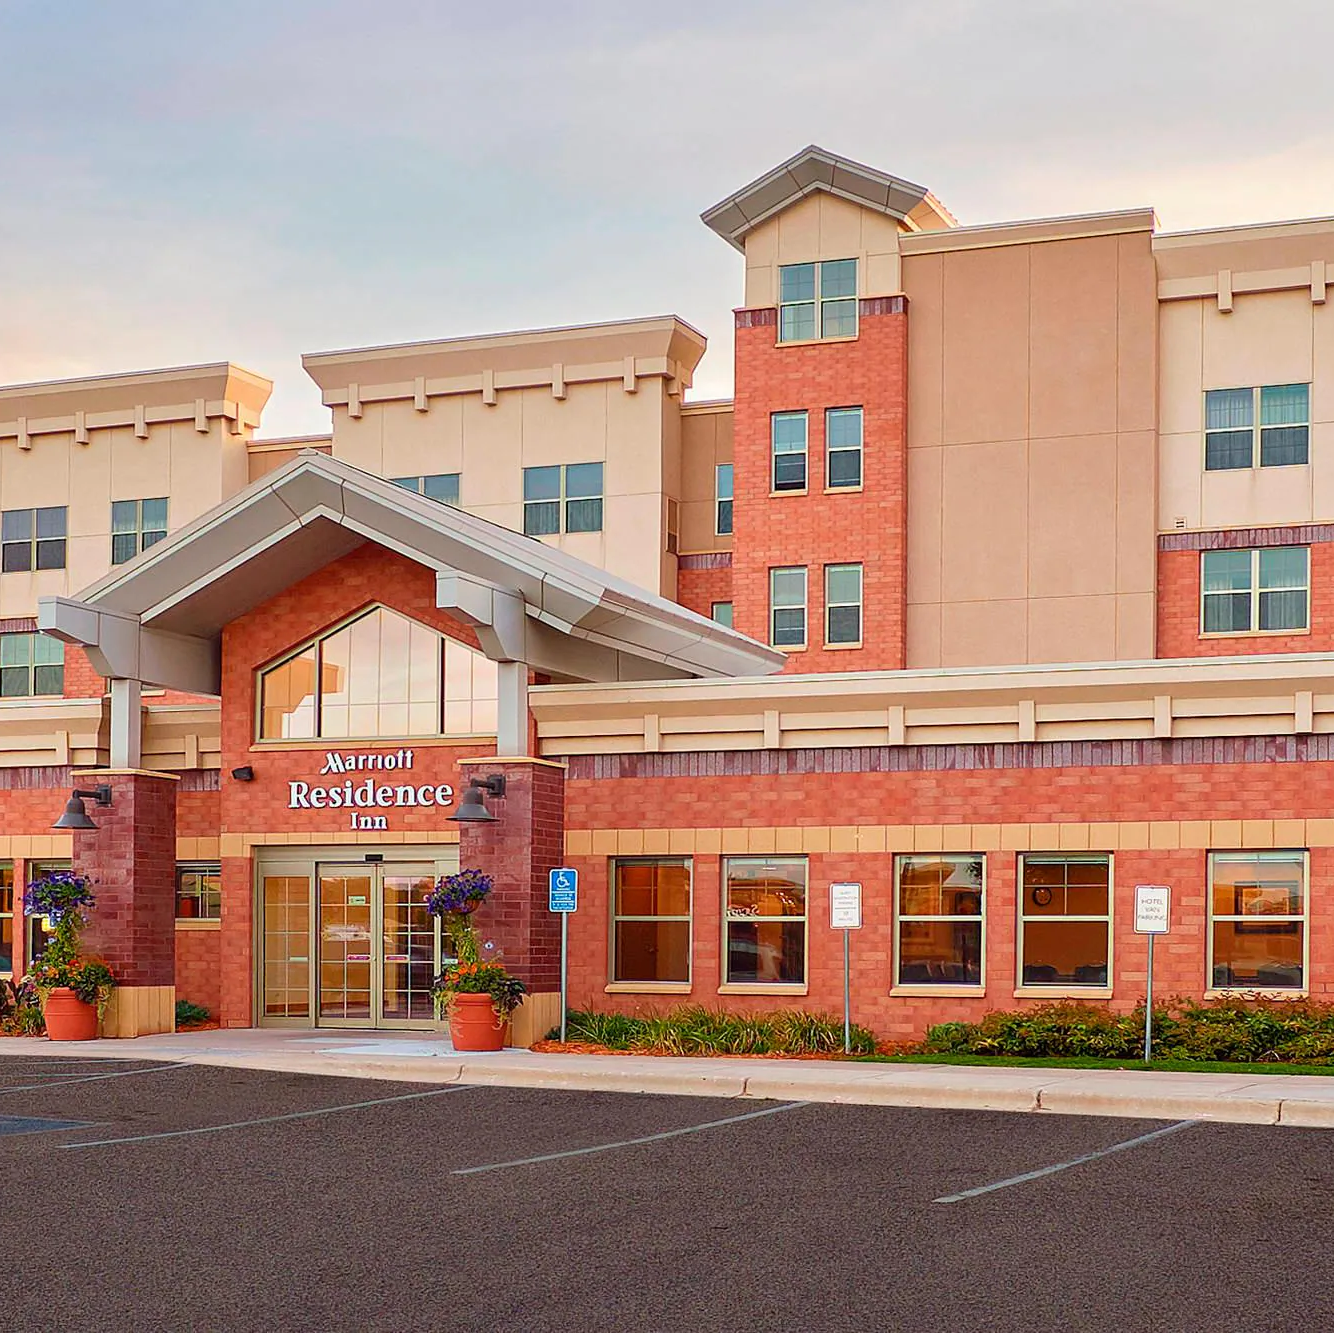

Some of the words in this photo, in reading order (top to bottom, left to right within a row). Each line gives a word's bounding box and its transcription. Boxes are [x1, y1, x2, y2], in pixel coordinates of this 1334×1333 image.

[320, 750, 413, 774] Marriott
[288, 779, 453, 808] Residence
[349, 811, 388, 830] Inn
